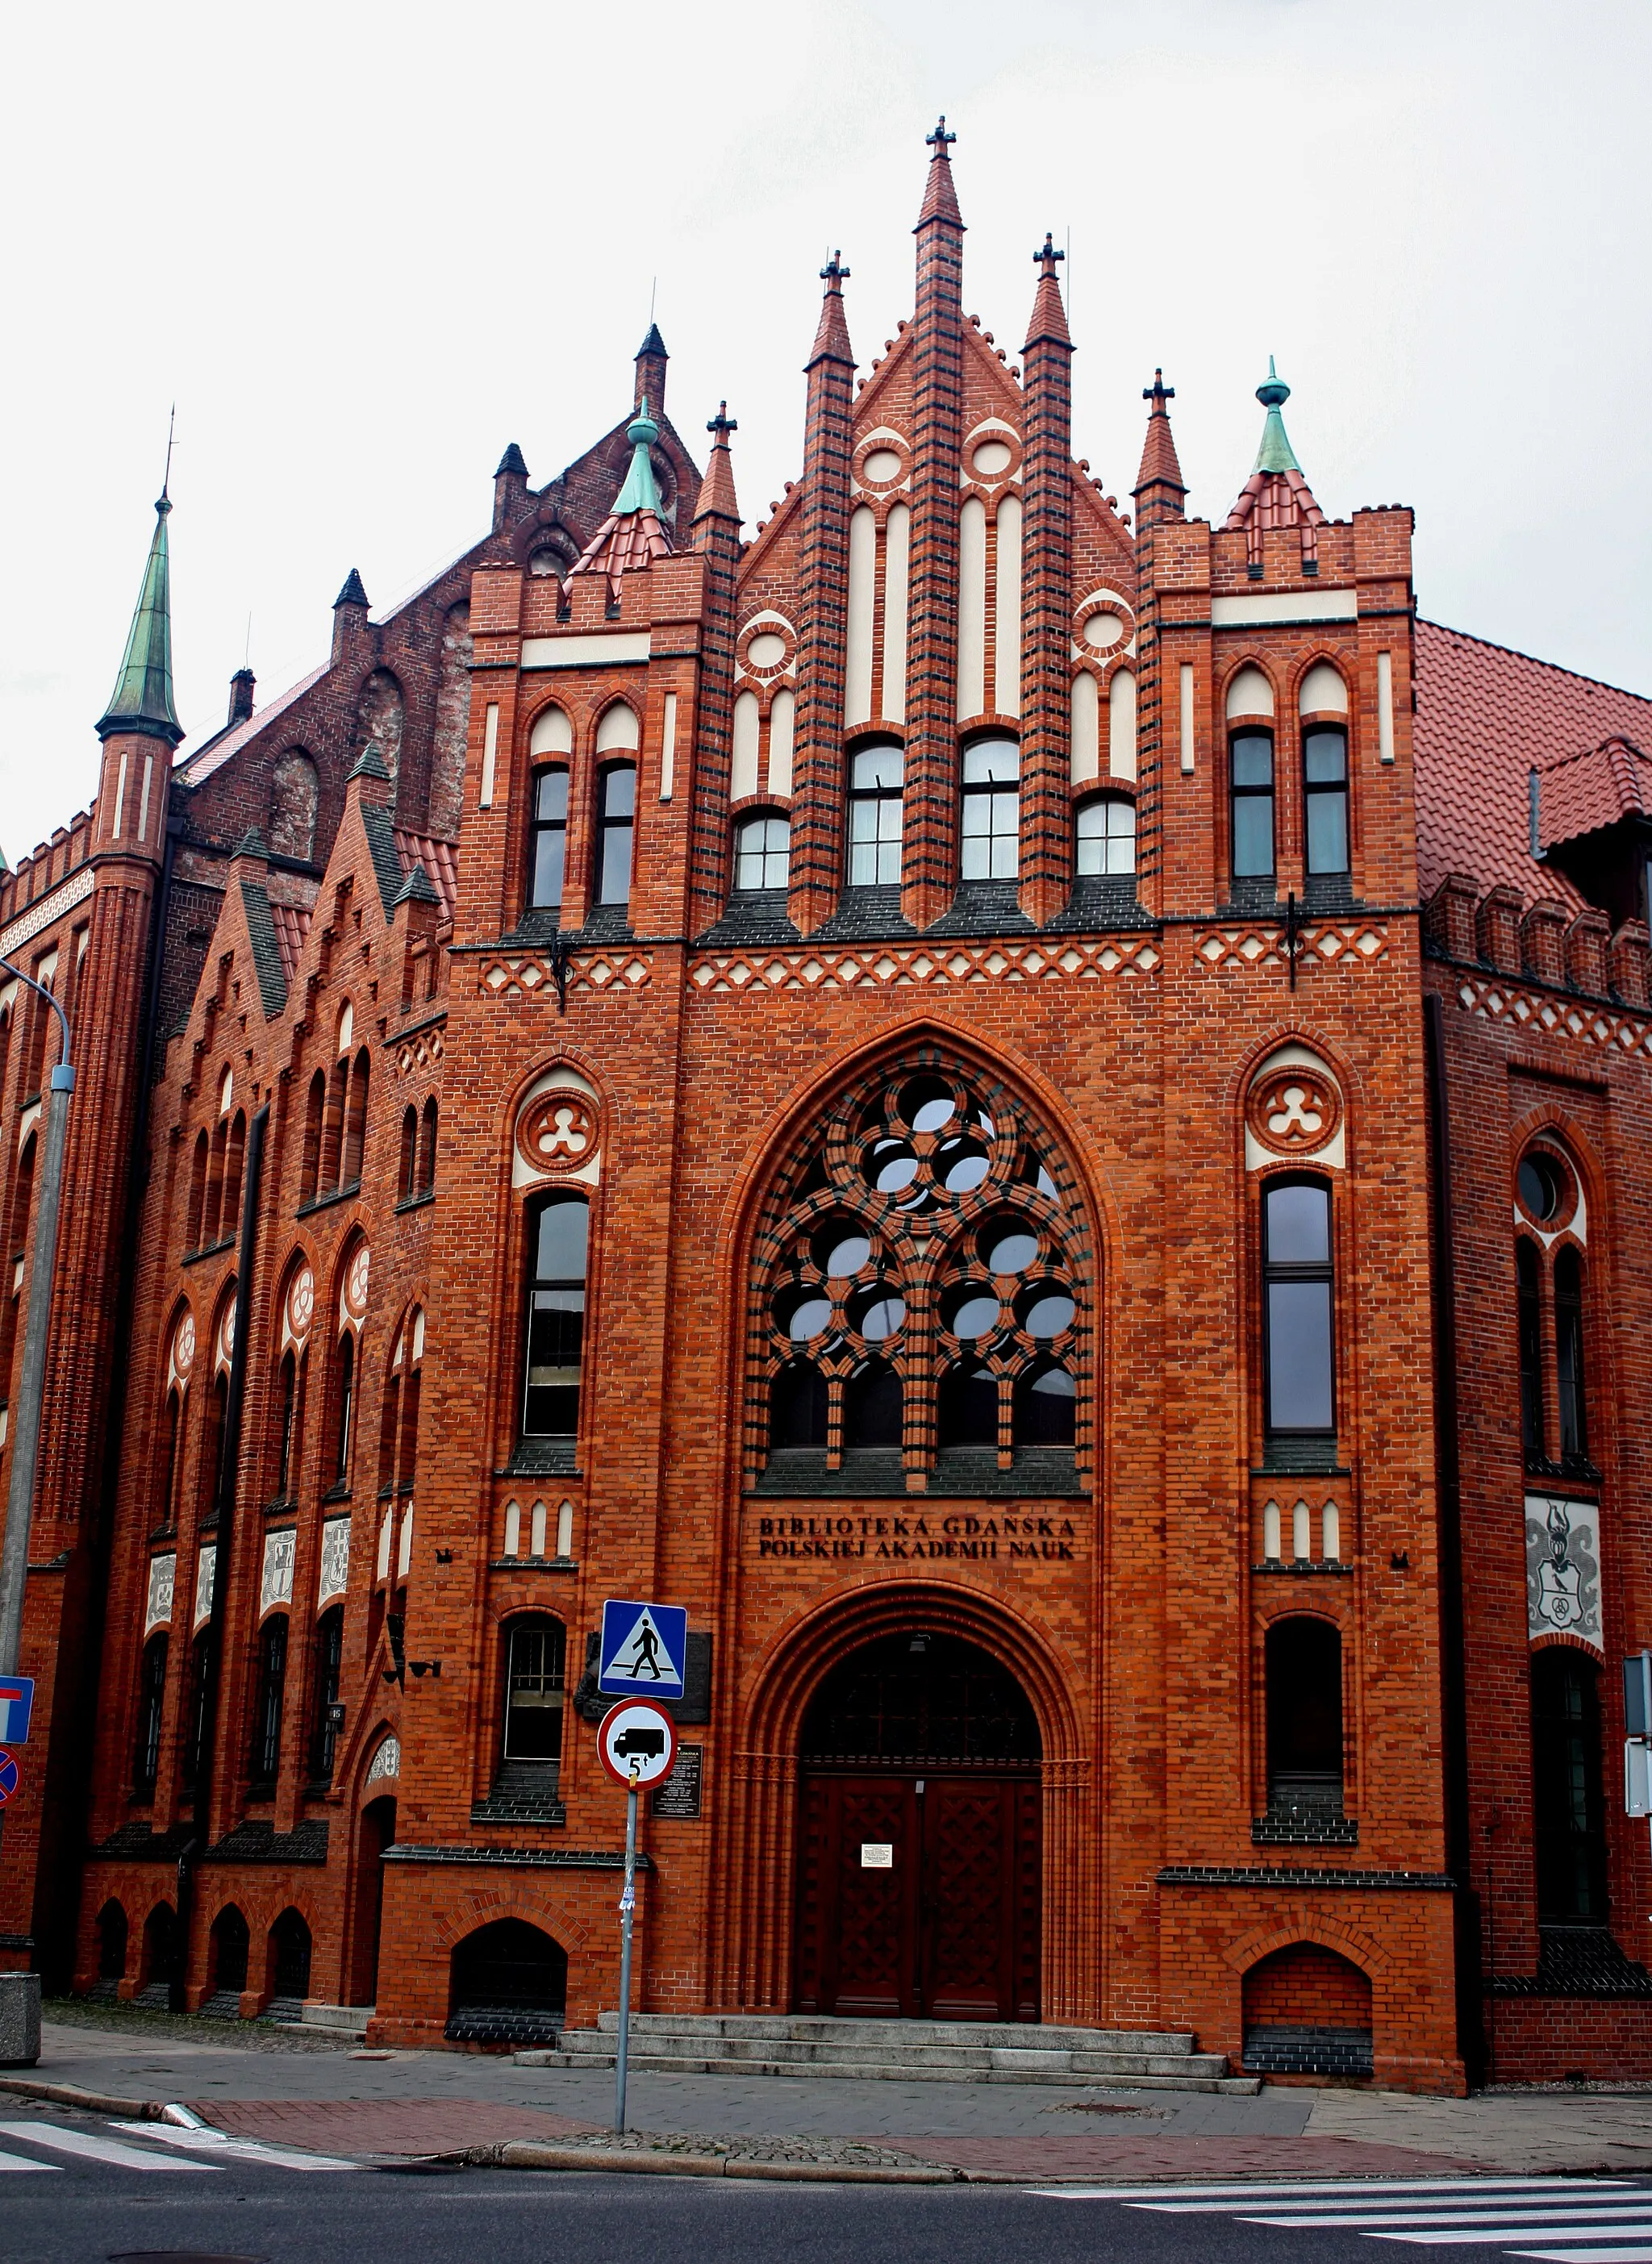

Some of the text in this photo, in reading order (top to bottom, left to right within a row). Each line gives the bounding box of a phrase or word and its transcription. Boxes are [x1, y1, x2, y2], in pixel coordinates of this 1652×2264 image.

[760, 1515, 1075, 1536] BIBLIOTEKA GDAŃSKA
[759, 1539, 1074, 1560] POLSKIEJ AKADEMII NAUK
